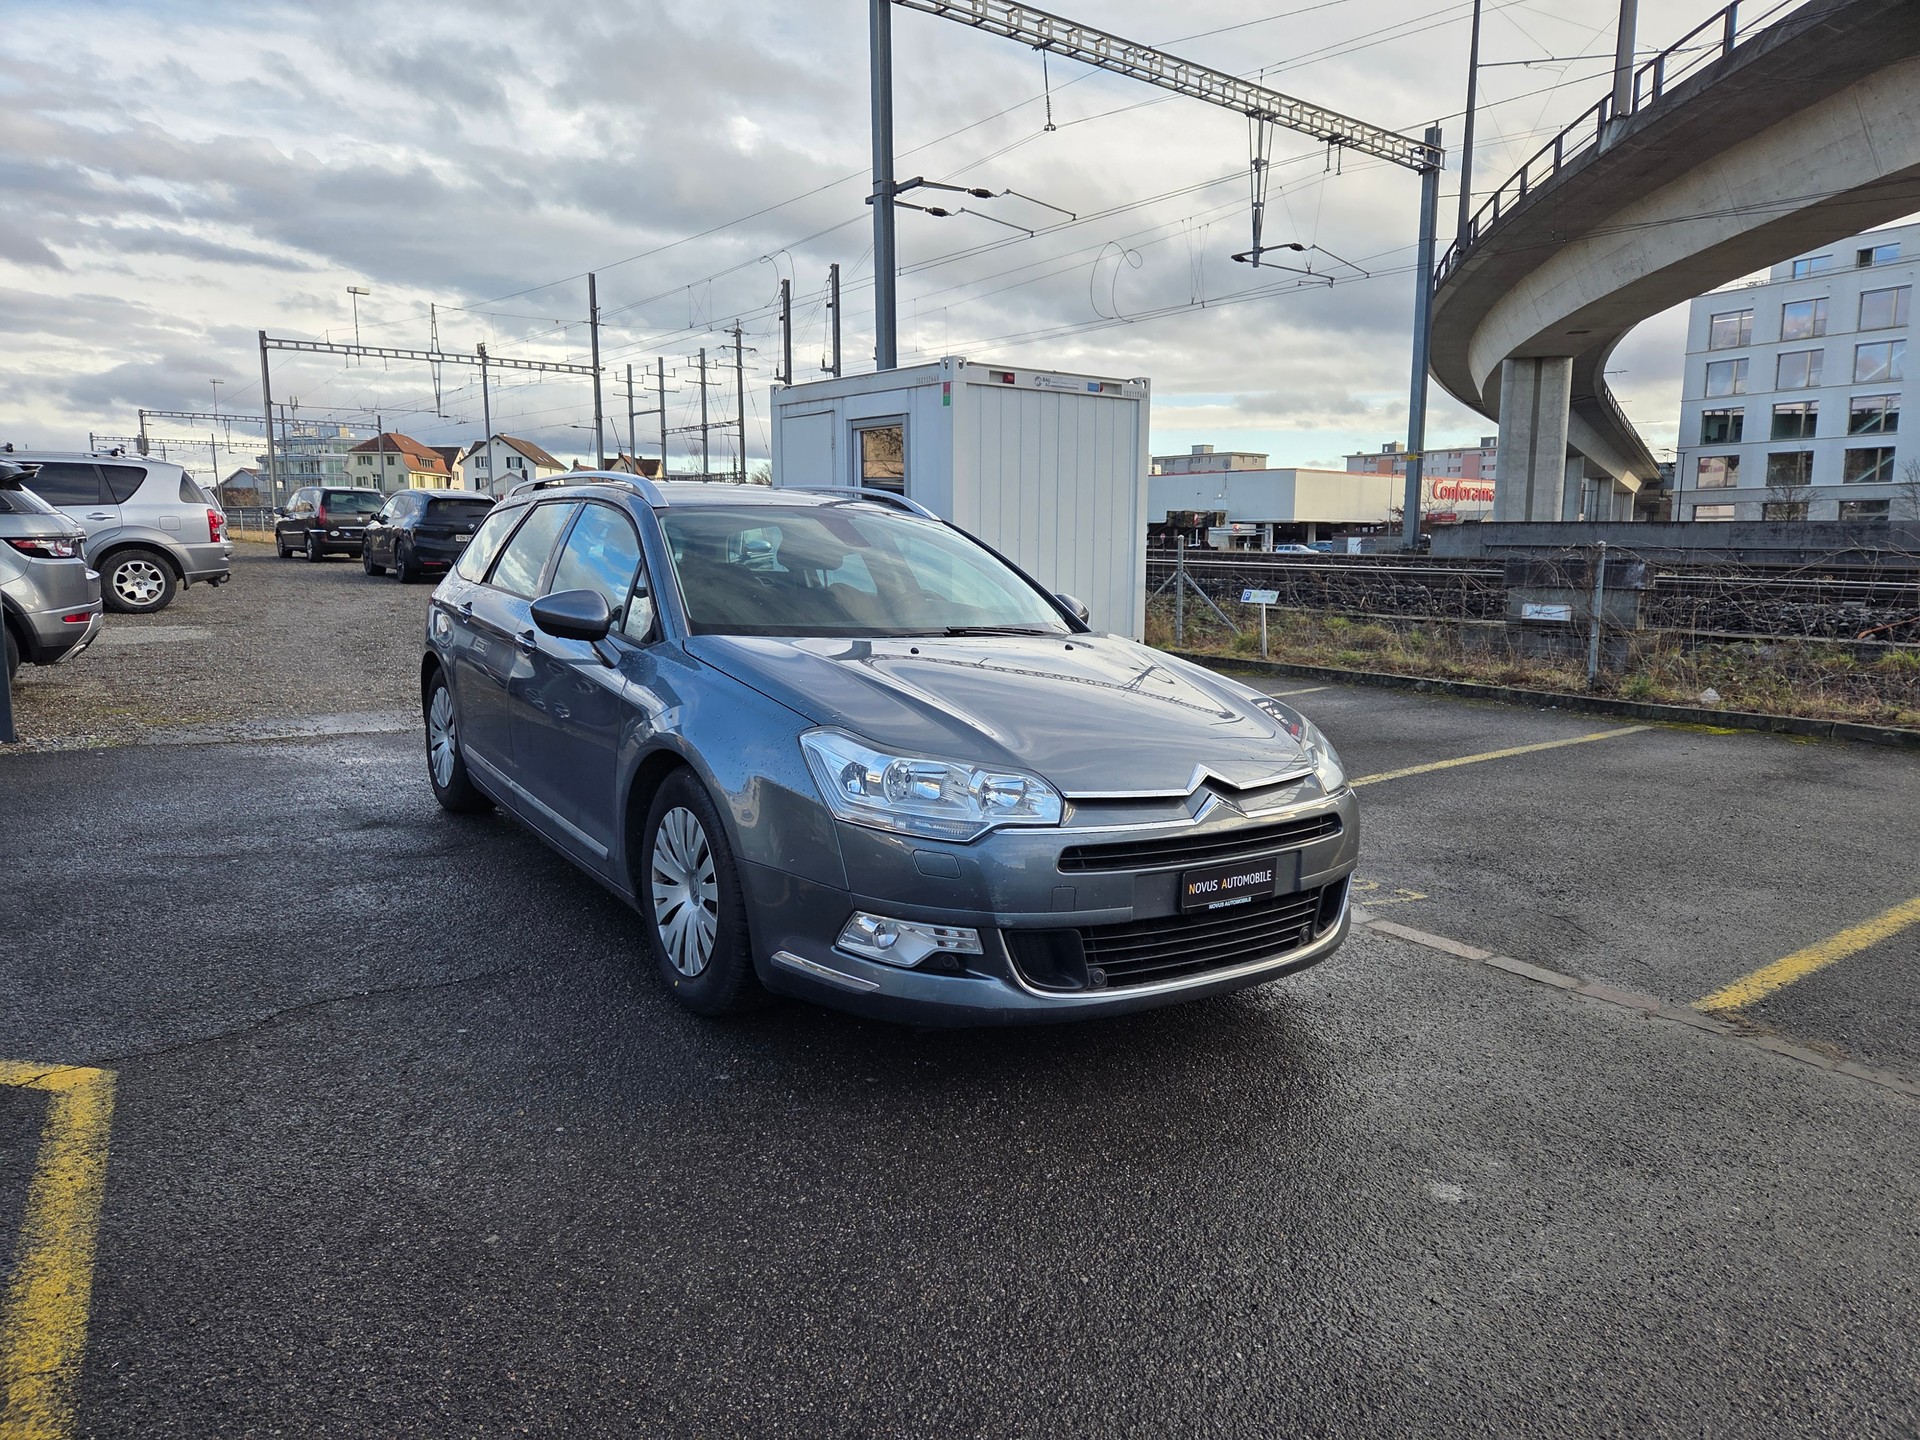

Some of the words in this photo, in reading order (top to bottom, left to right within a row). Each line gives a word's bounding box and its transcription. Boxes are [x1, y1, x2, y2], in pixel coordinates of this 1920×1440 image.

[1433, 479, 1494, 503] Conforama
[1188, 879, 1218, 895] NOVUS
[1221, 869, 1272, 890] AUTOMOBILE
[1208, 901, 1225, 910] NOVUS
[1225, 896, 1252, 907] AUTOMOBILE
